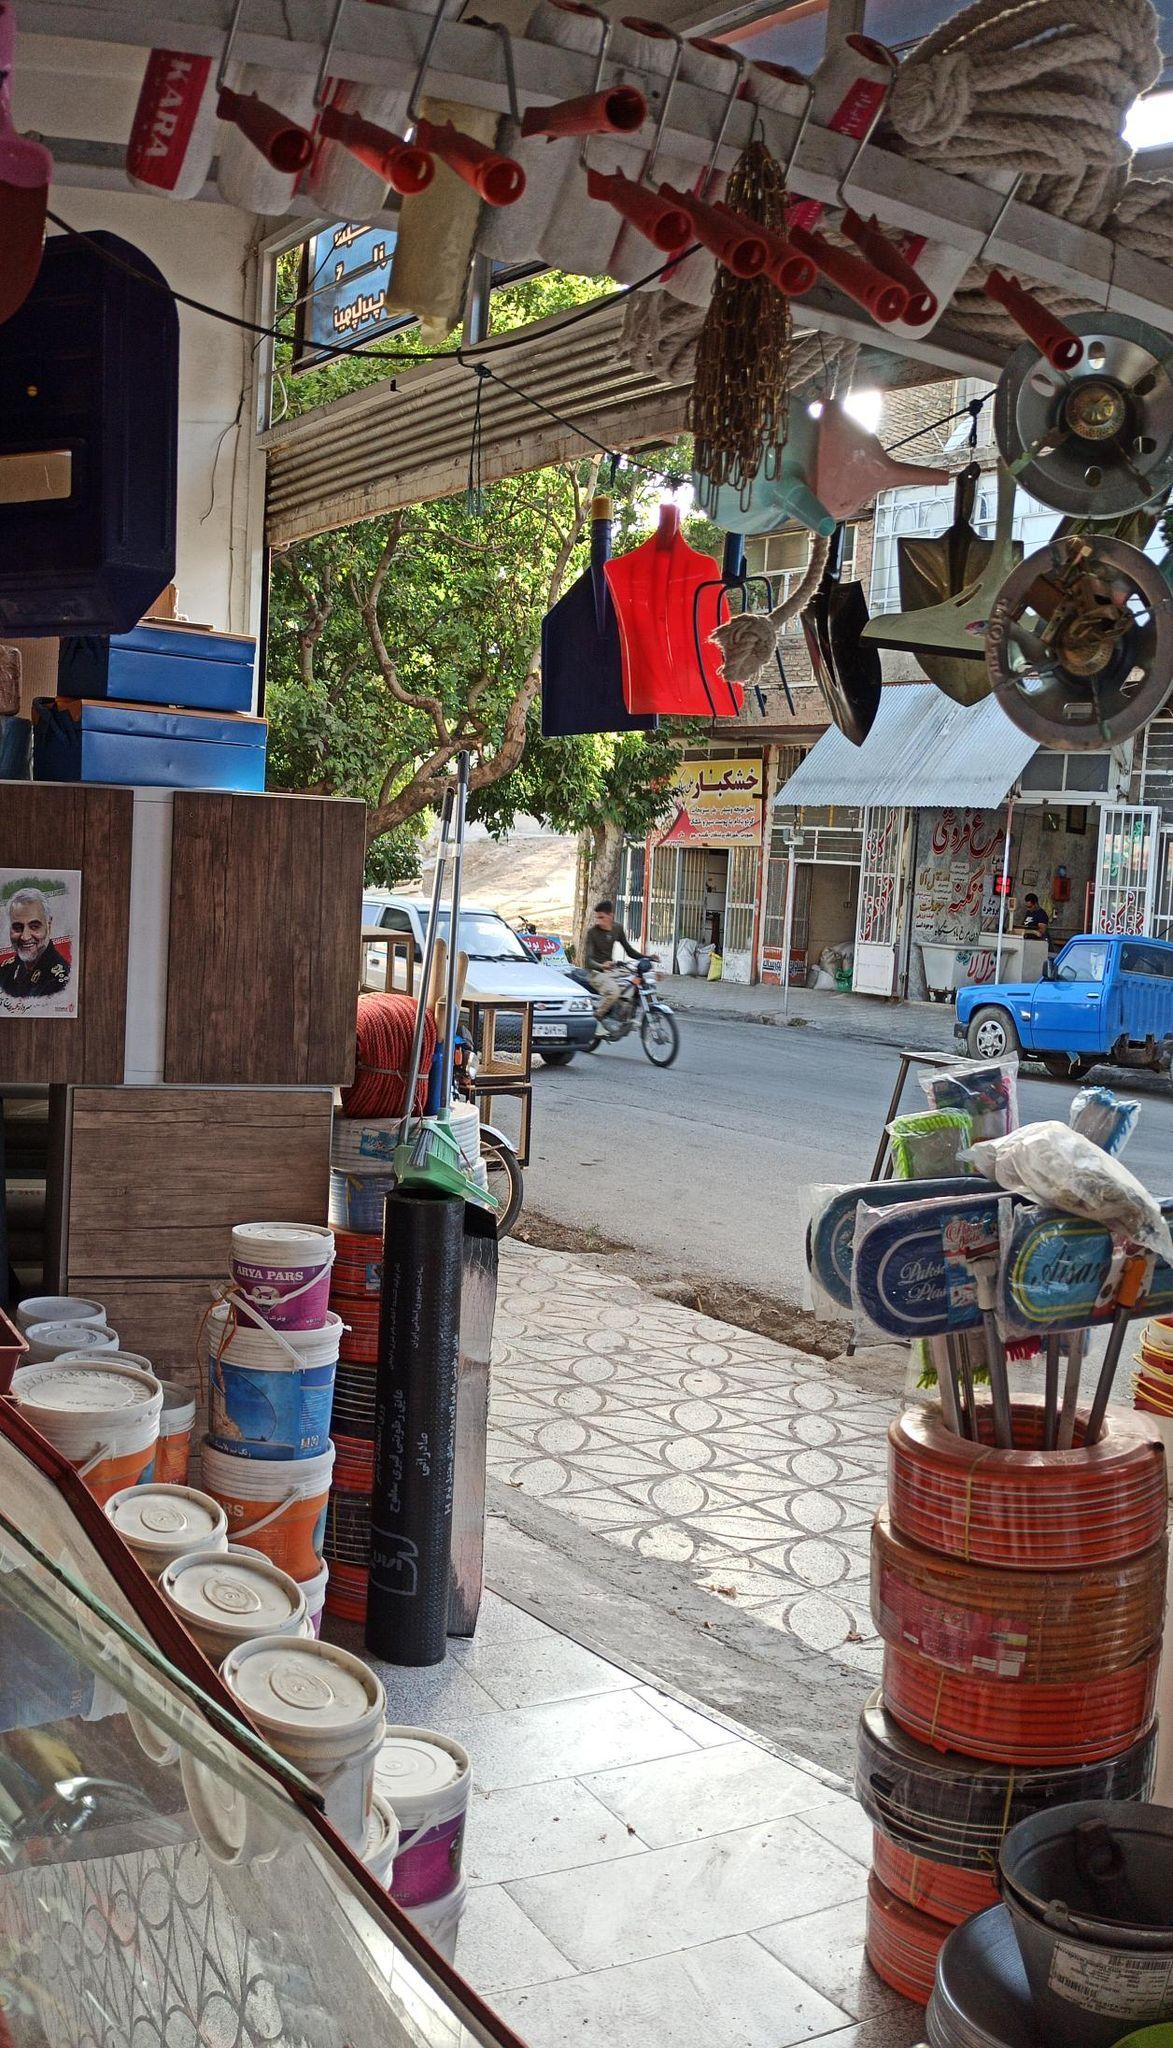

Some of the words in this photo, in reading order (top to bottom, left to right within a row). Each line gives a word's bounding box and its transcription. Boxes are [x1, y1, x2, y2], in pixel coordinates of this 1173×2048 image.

[144, 60, 192, 157] KARA
[692, 768, 759, 799] خشکبار
[932, 808, 971, 856] فروشی
[237, 1266, 263, 1280] ARYA
[266, 1271, 304, 1281] PARS
